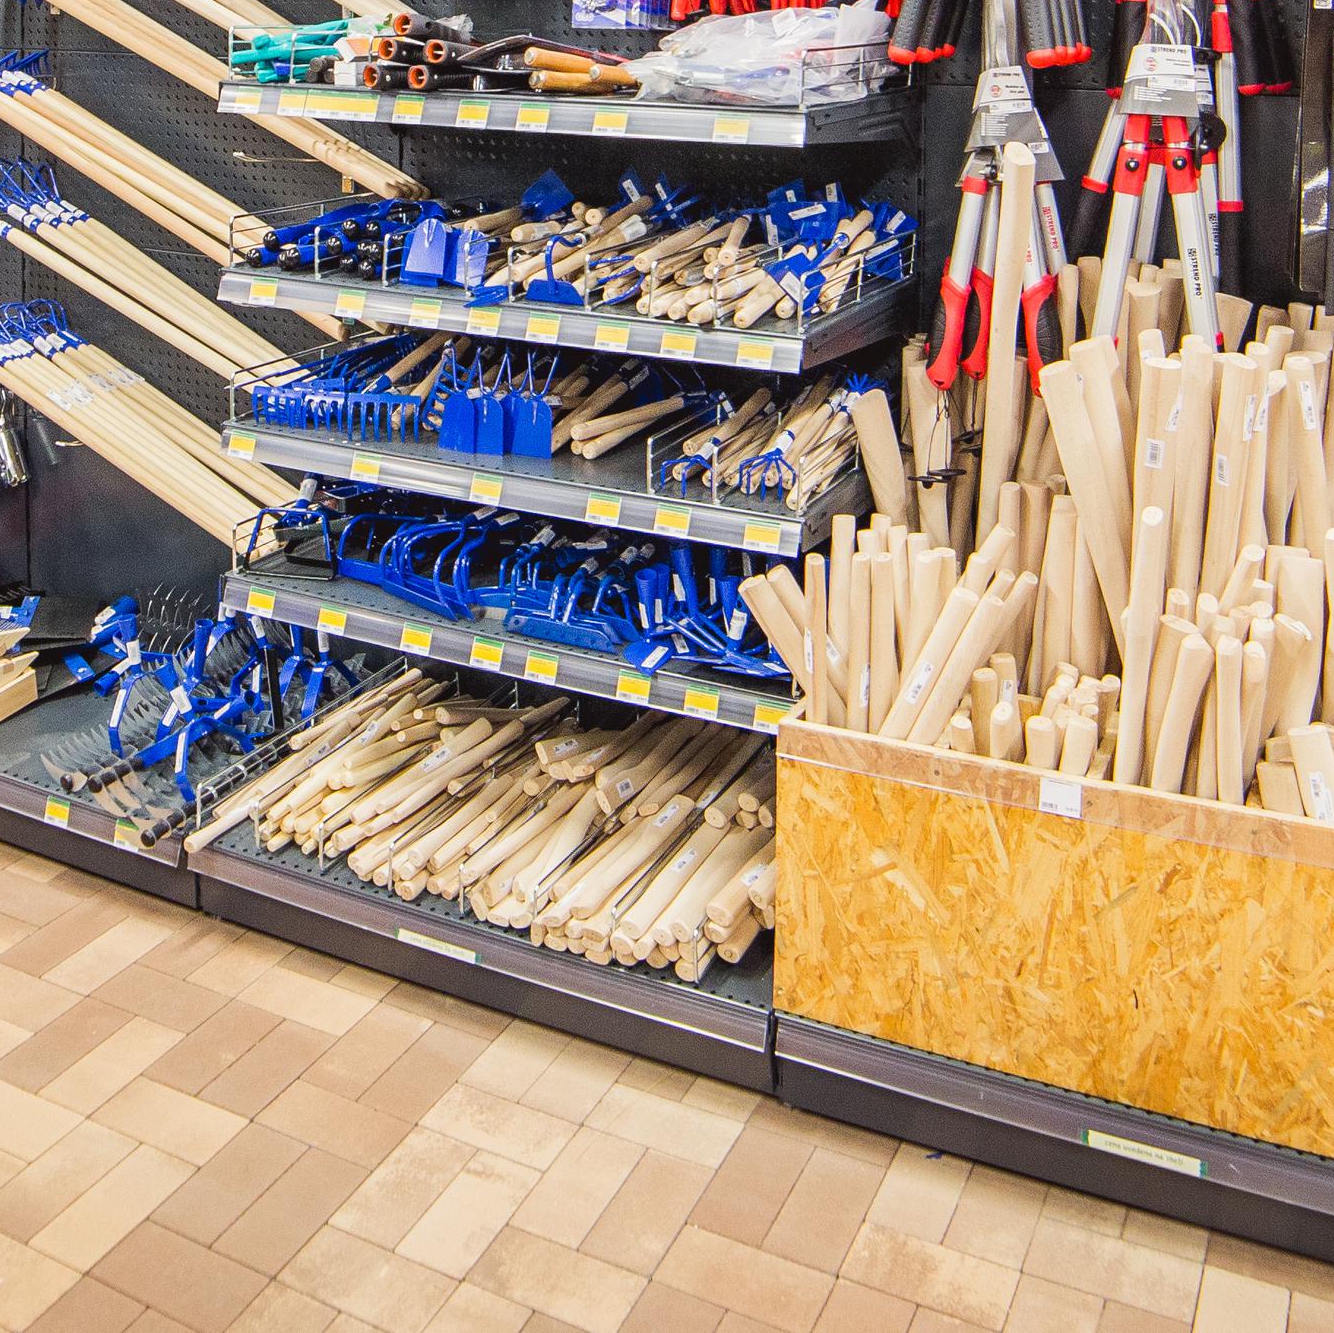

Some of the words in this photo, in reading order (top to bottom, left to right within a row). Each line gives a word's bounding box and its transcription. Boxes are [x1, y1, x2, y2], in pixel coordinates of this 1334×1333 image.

[1046, 214, 1056, 236] STREND
[1051, 237, 1059, 249] PRO
[1191, 256, 1200, 281] STREND
[1195, 283, 1203, 296] PRO
